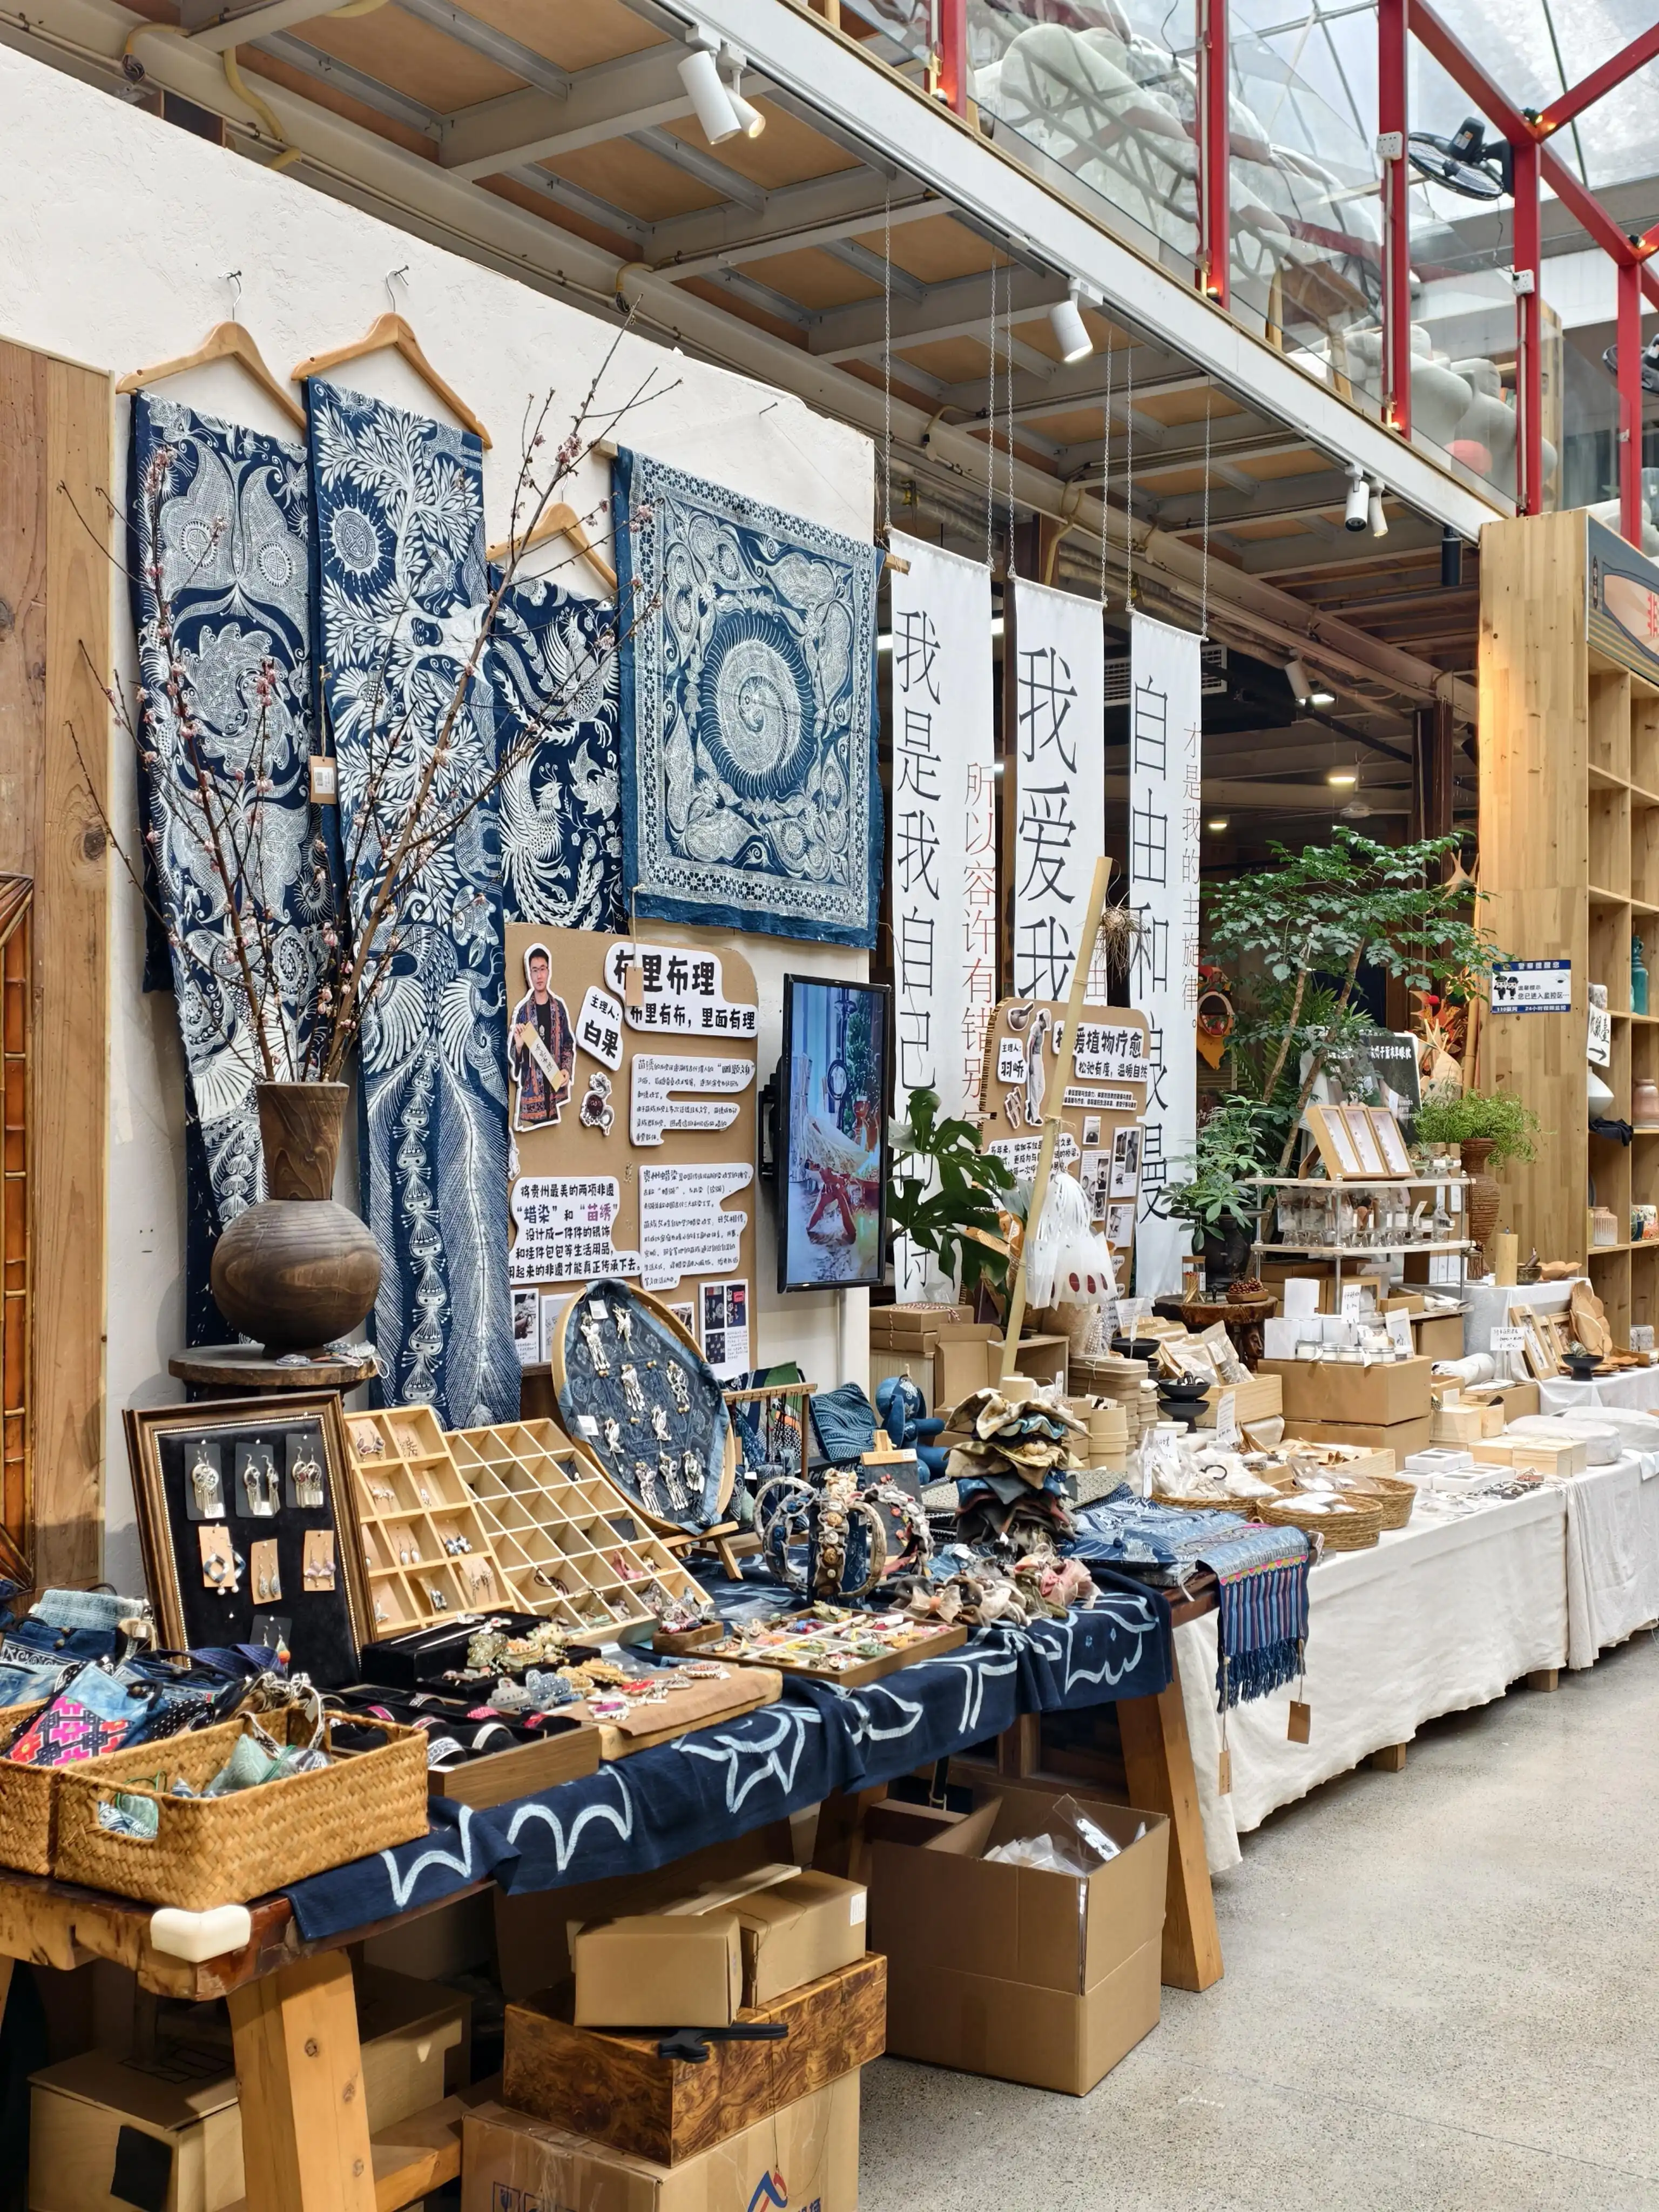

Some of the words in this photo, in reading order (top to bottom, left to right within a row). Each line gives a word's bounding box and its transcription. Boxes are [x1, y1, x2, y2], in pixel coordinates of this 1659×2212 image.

[1018, 646, 1078, 1001] 我爱我
[1182, 721, 1201, 1028] 才是我的主旋律。
[962, 761, 997, 1122] 所以容许有错别
[613, 949, 714, 995] 布里布理
[630, 1003, 755, 1030] 布里有布，里面有理
[584, 1020, 619, 1058] 白果
[521, 1183, 615, 1198] 将贵州最美的两项非遗
[516, 1242, 614, 1260] 和挂件包包等生活用品，
[525, 1225, 610, 1241] 设计成一件件的银饰
